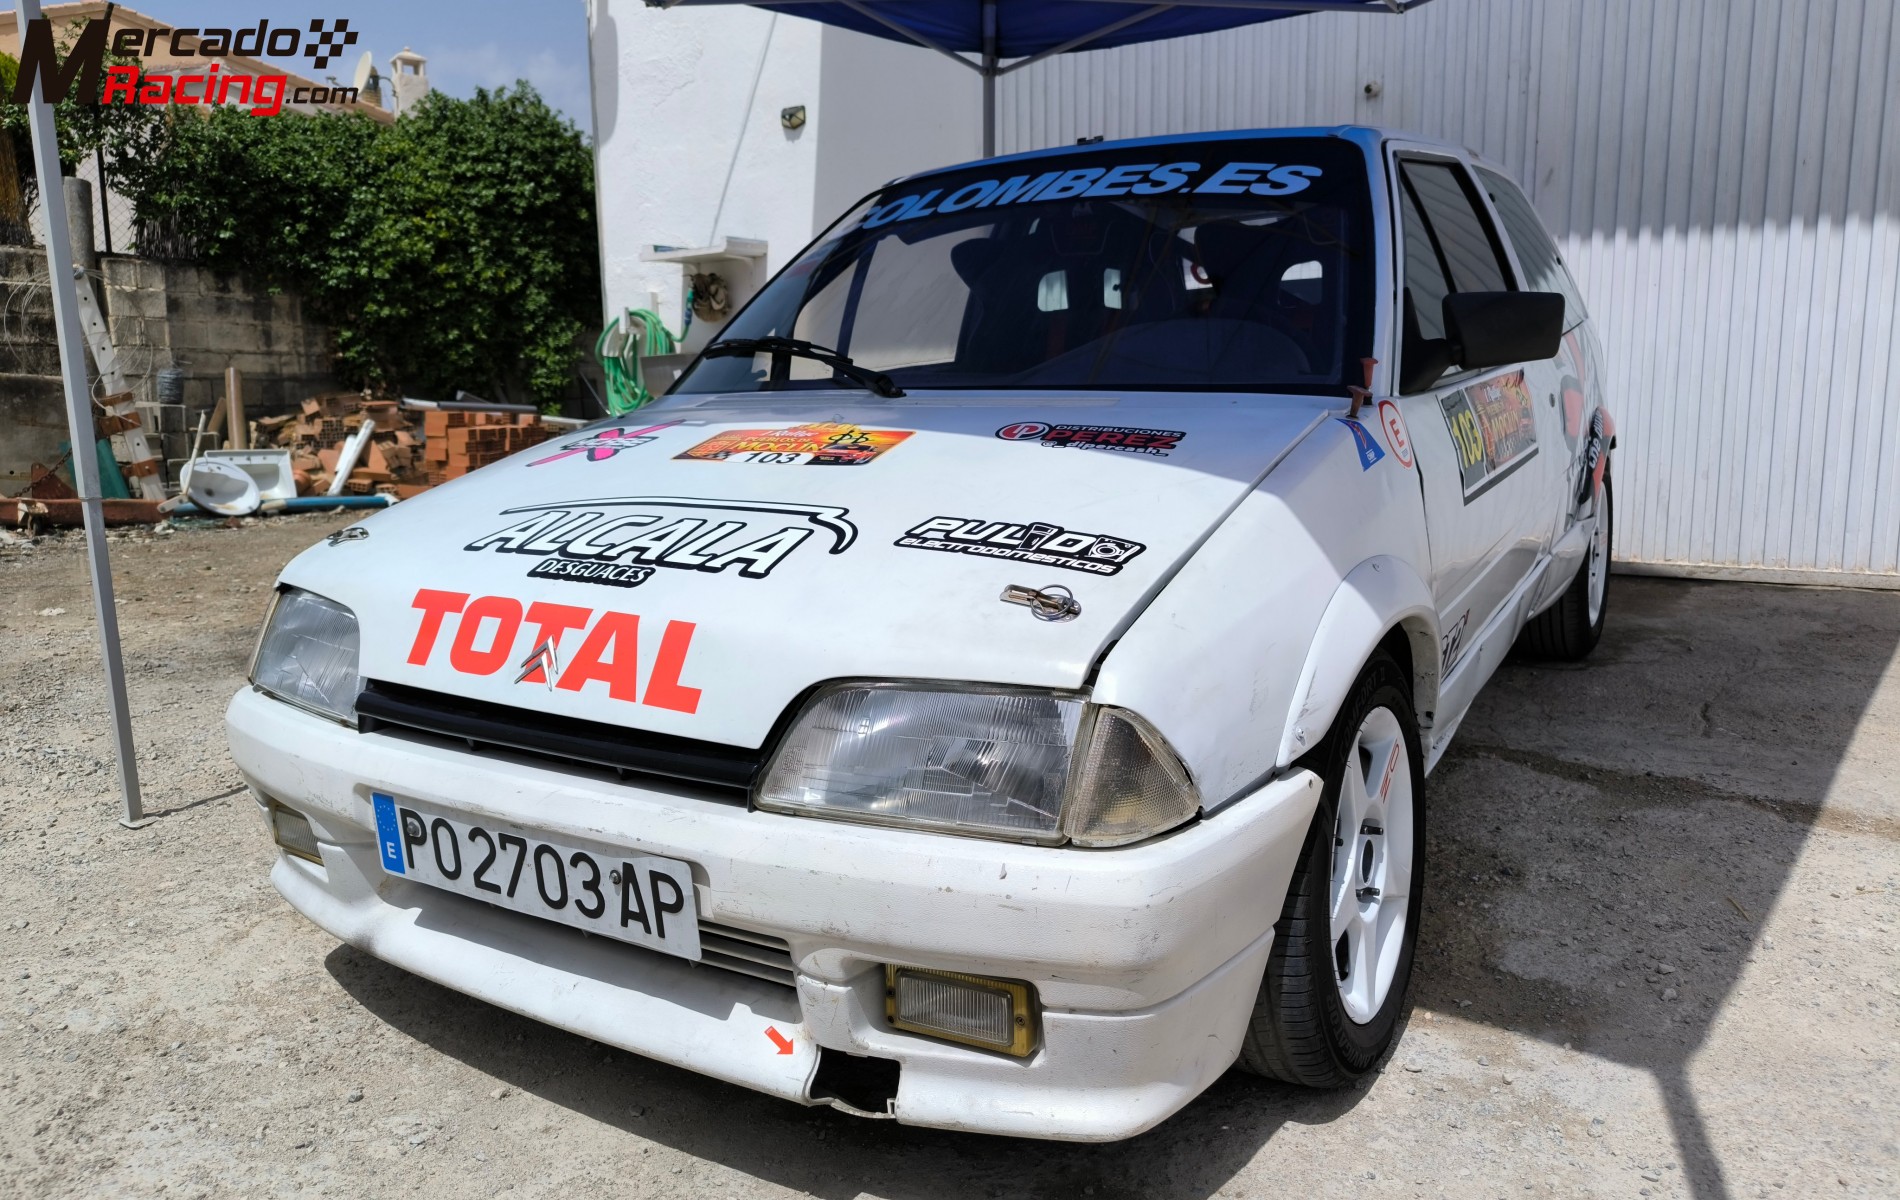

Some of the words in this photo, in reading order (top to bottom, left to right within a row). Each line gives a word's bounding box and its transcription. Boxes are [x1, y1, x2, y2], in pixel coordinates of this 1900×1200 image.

[1045, 429, 1178, 448] PEREZ
[1055, 425, 1182, 437] DISTRIBUCIONES
[1389, 418, 1405, 447] E
[1451, 409, 1483, 468] 103
[743, 452, 801, 464] 103
[463, 510, 815, 579] ALCALA
[536, 558, 652, 584] DESGUACES
[406, 588, 703, 715] TOTAL
[385, 842, 397, 859] E
[468, 827, 606, 919] 2703
[620, 861, 685, 939] AP
